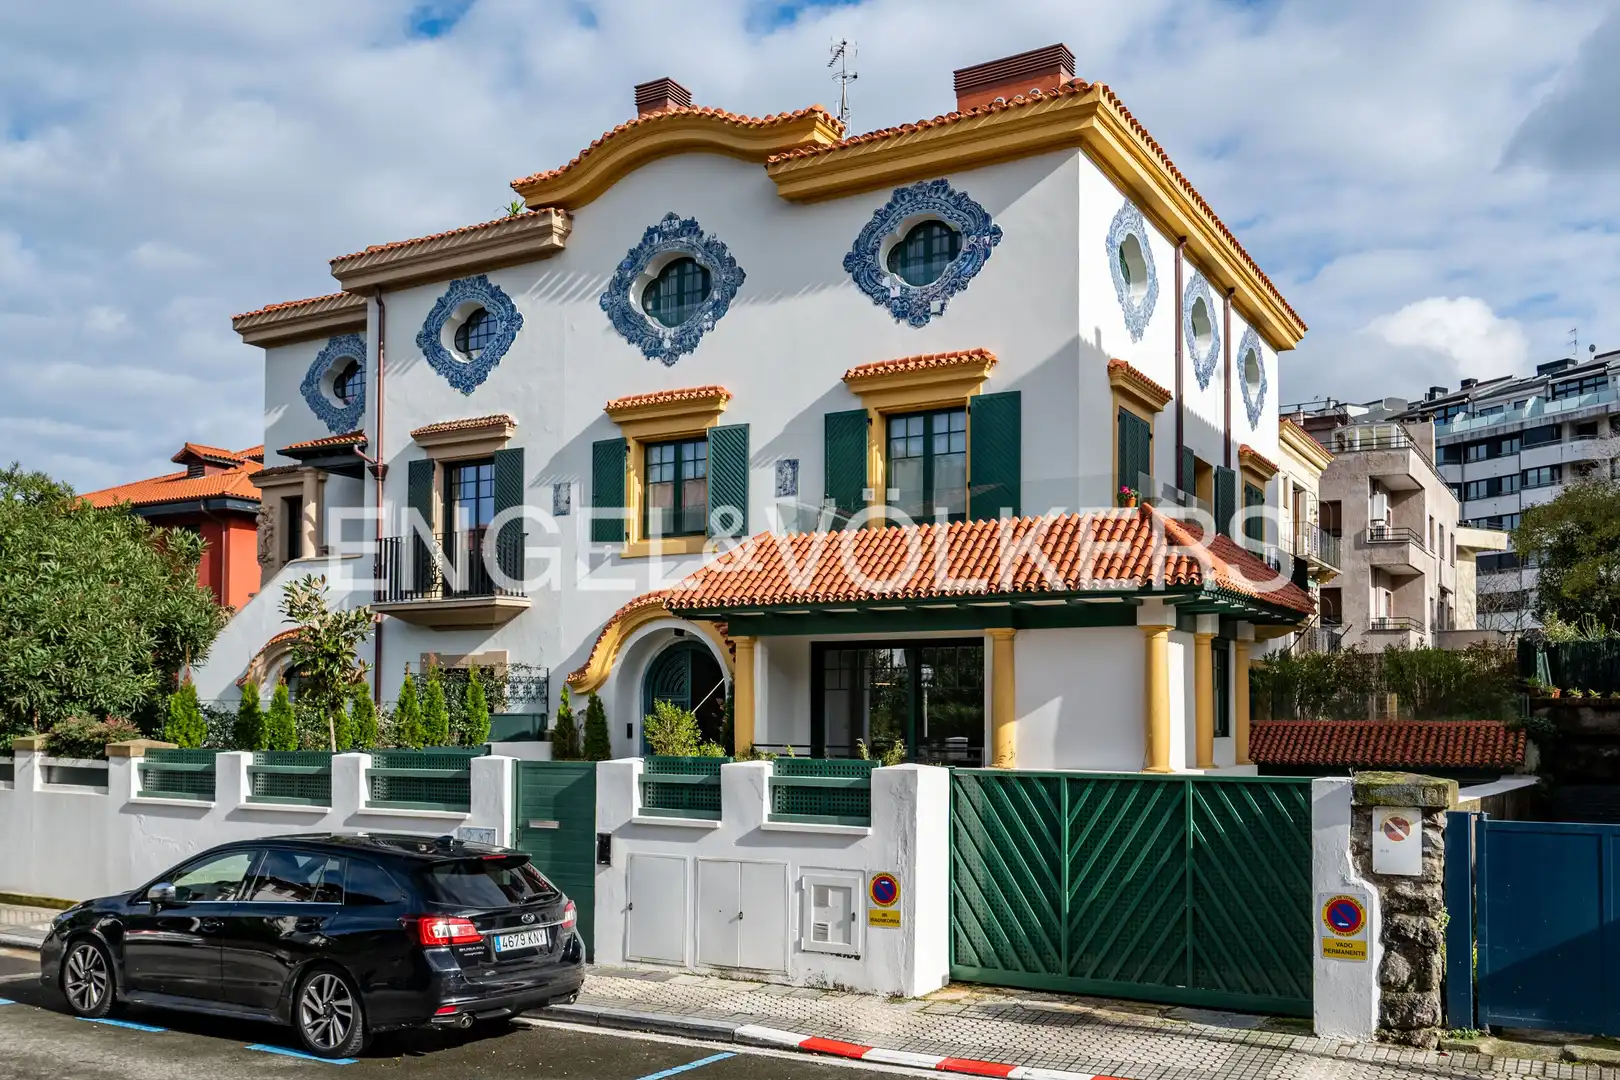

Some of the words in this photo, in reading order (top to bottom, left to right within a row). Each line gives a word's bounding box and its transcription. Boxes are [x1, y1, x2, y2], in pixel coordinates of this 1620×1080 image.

[502, 933, 526, 948] 4679
[528, 931, 544, 944] KNY
[1324, 948, 1366, 956] PERMANENTE
